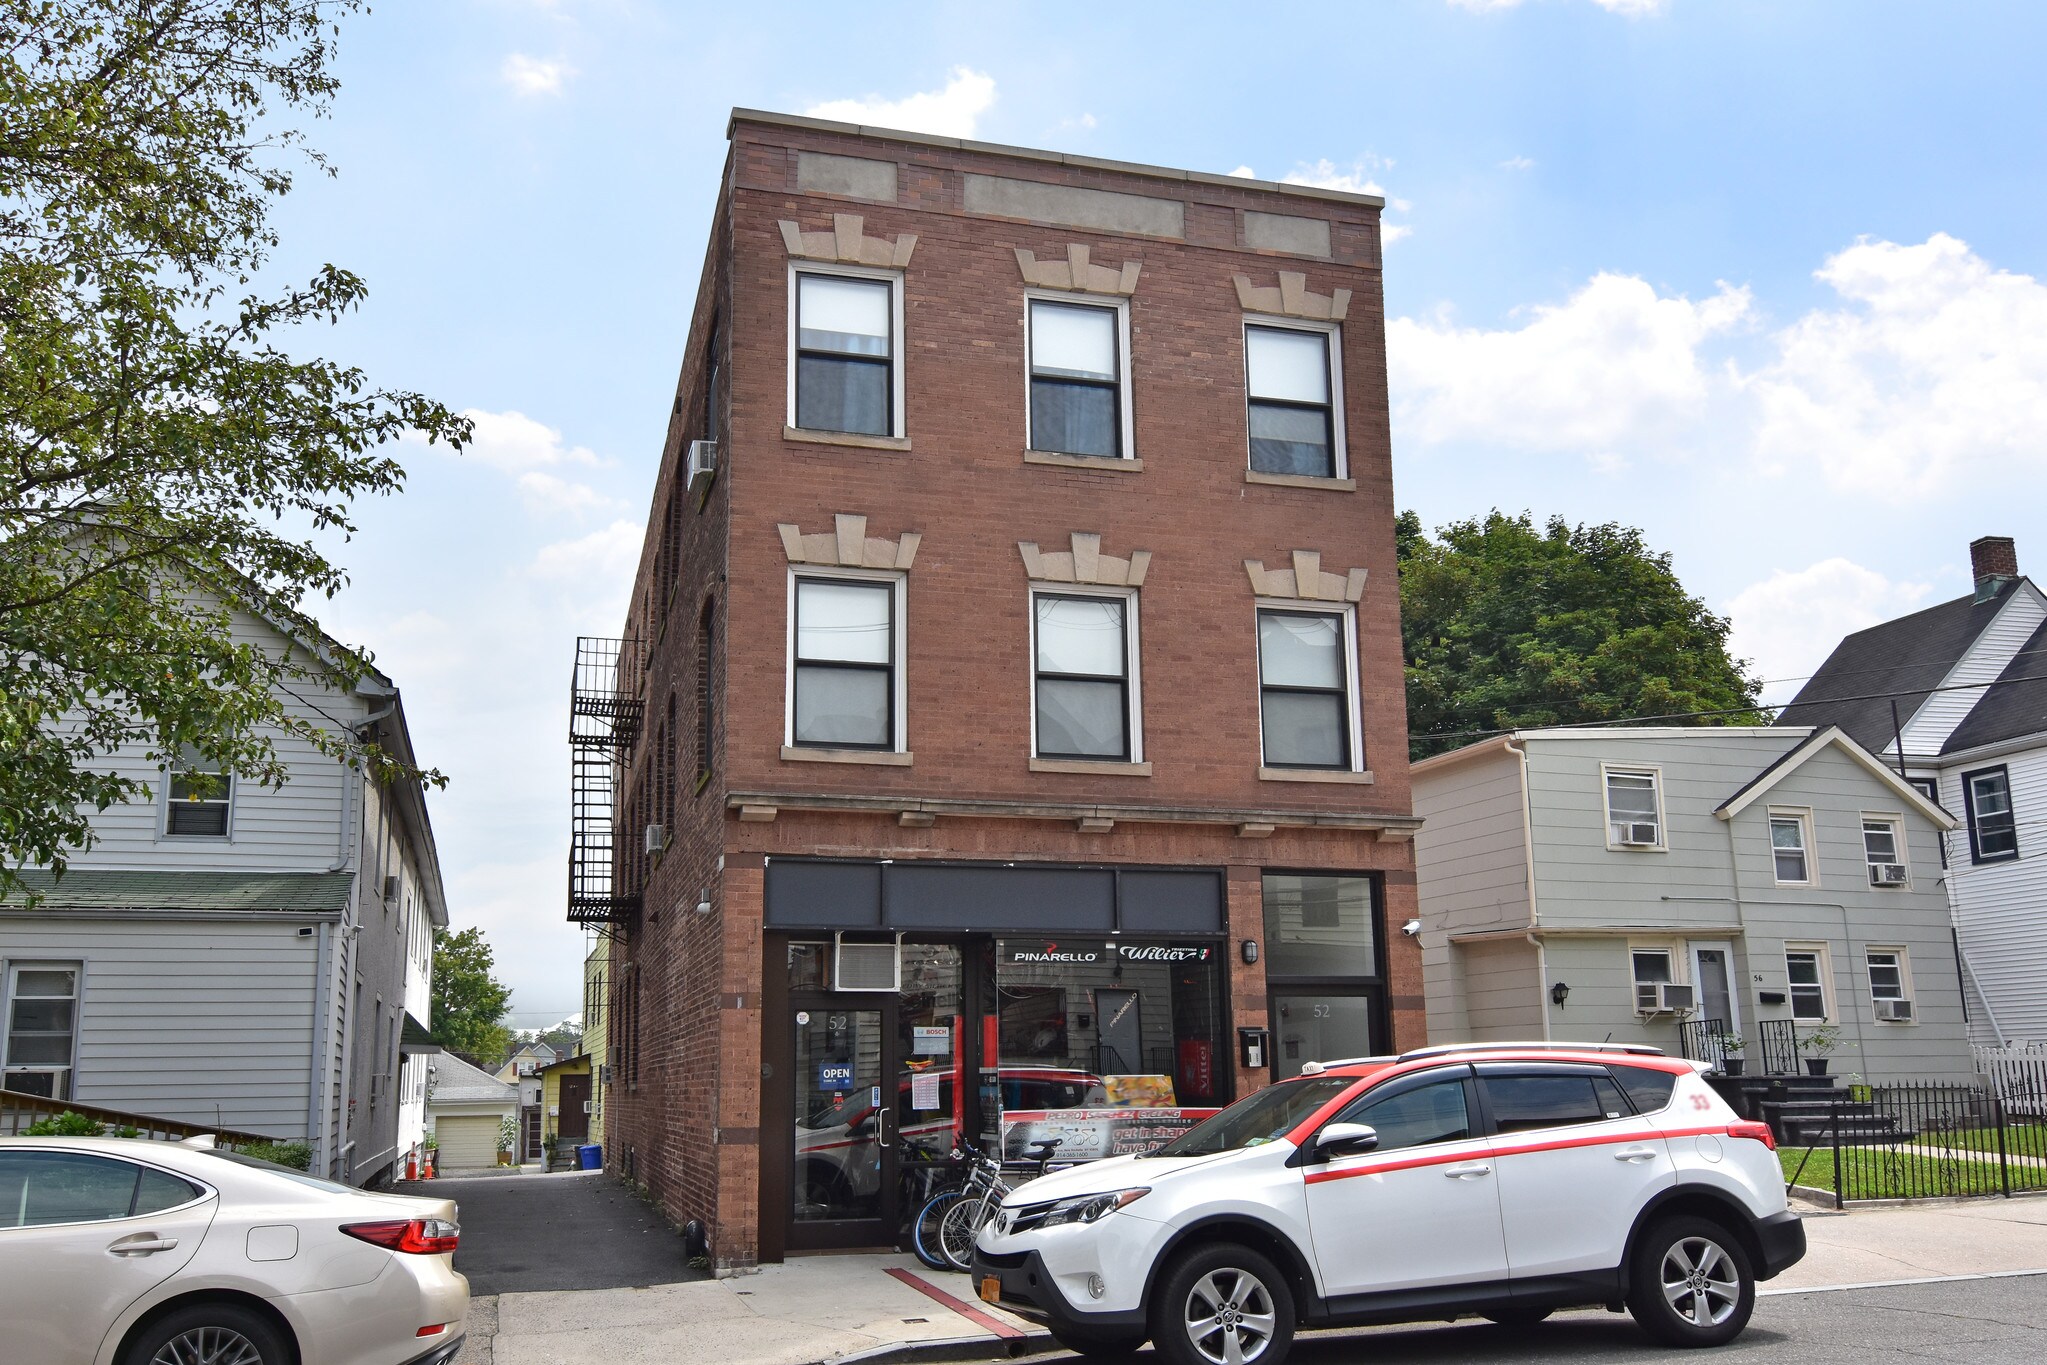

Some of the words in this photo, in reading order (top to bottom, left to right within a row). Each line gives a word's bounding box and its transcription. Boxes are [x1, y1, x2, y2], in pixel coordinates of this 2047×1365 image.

[1014, 953, 1096, 962] PINARELLO
[1119, 946, 1197, 960] Wilier
[1753, 974, 1763, 982] 56
[1313, 1004, 1330, 1018] 52
[828, 1016, 847, 1030] 52
[823, 1068, 850, 1079] OPEN
[1046, 1111, 1082, 1120] PEDRO
[1113, 1128, 1138, 1141] get
[1139, 1127, 1151, 1138] in
[1153, 1126, 1189, 1139] shap
[1112, 1142, 1146, 1154] have
